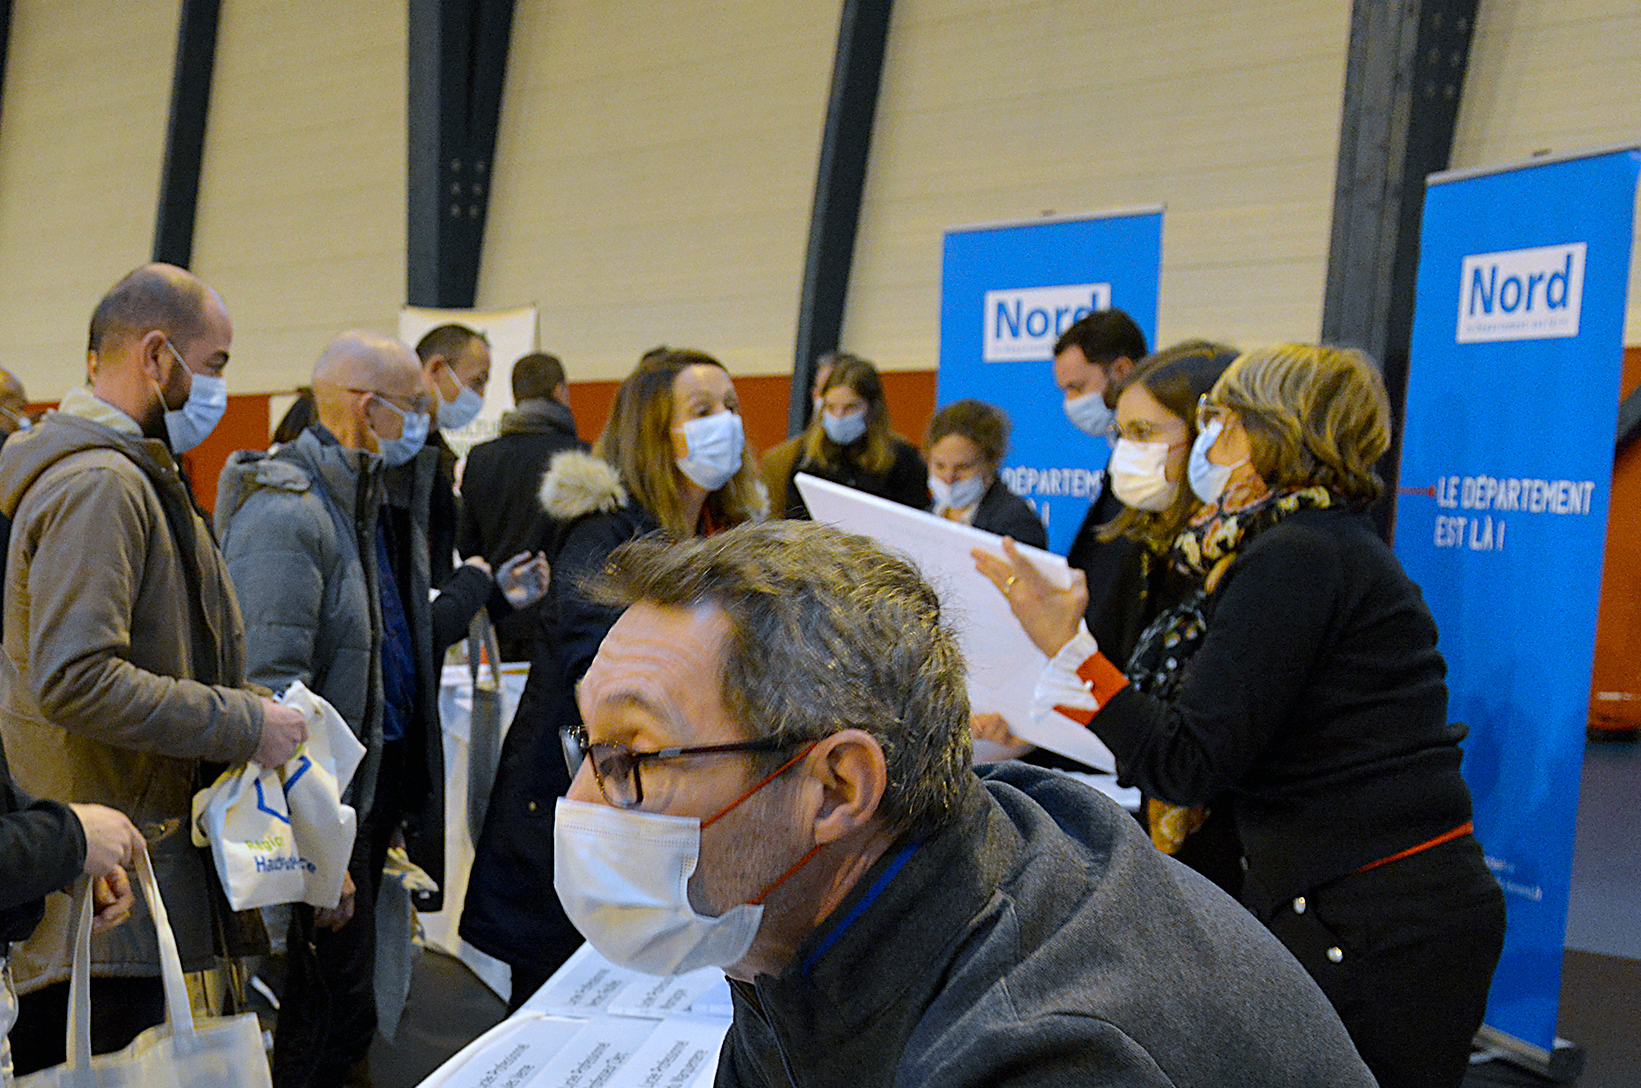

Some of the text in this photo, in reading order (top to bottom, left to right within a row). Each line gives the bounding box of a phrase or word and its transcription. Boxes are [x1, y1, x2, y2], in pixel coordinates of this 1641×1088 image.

[1469, 252, 1573, 316] Nord
[1436, 473, 1596, 516] LE DÉPARTEMENT
[1433, 514, 1468, 548] EST
